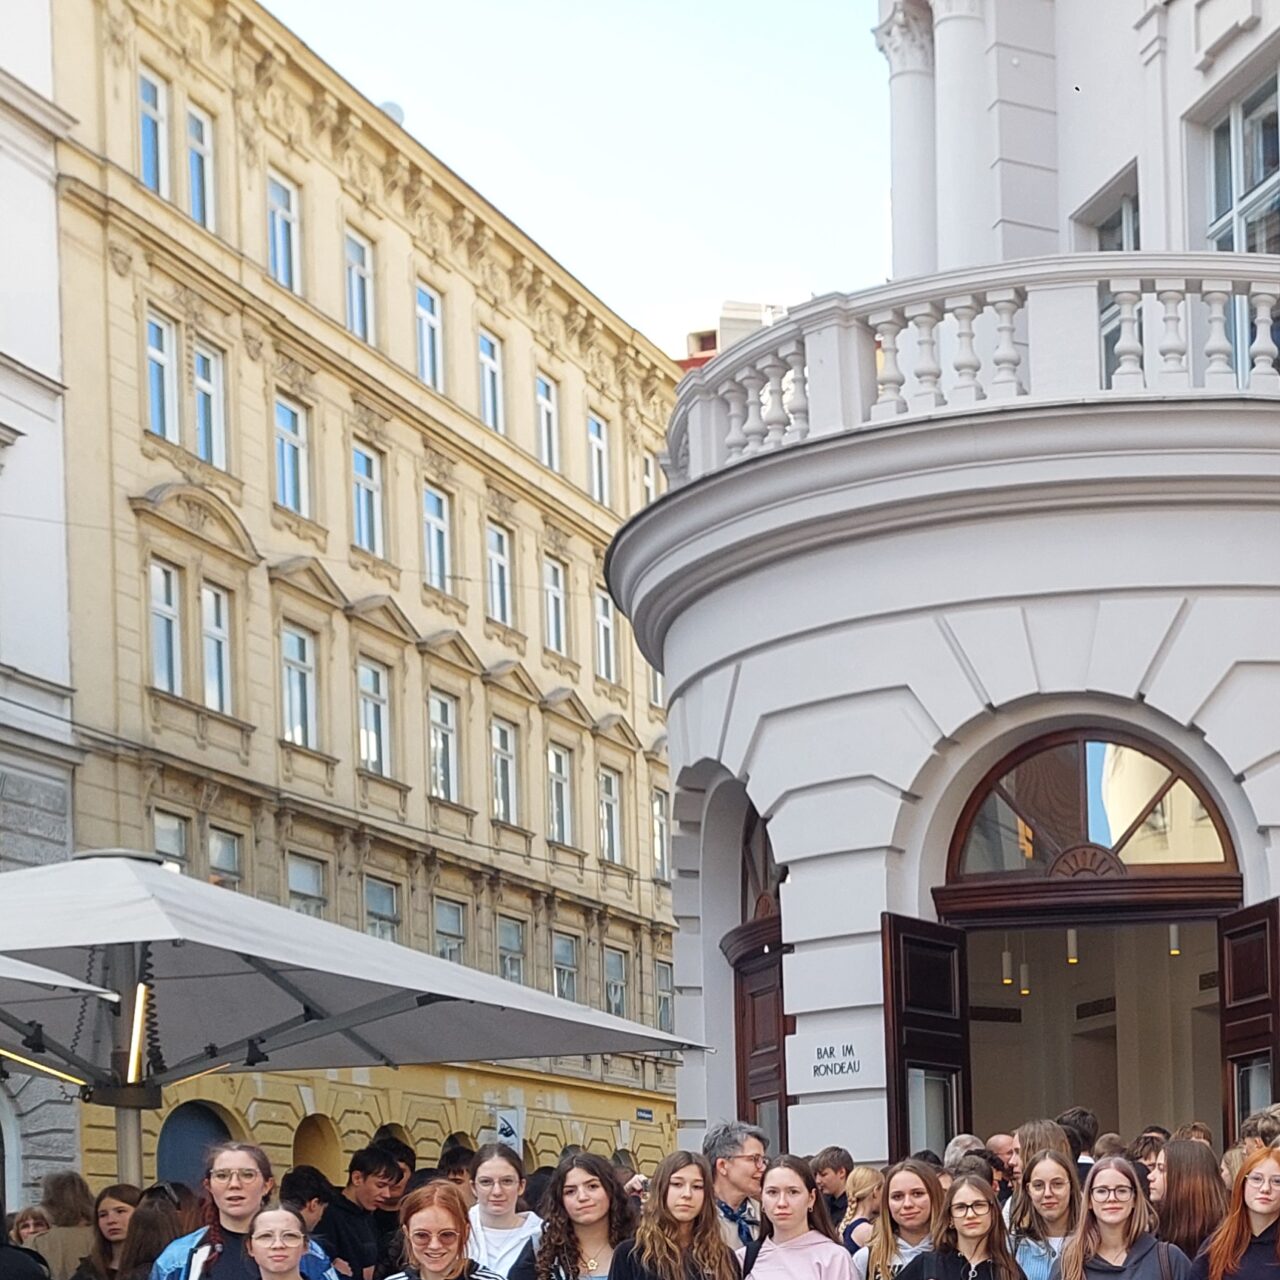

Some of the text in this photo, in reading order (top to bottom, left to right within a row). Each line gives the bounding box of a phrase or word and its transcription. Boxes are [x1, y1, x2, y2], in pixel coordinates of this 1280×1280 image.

[816, 1044, 855, 1060] BAR IM
[813, 1060, 861, 1078] RONDEAU
